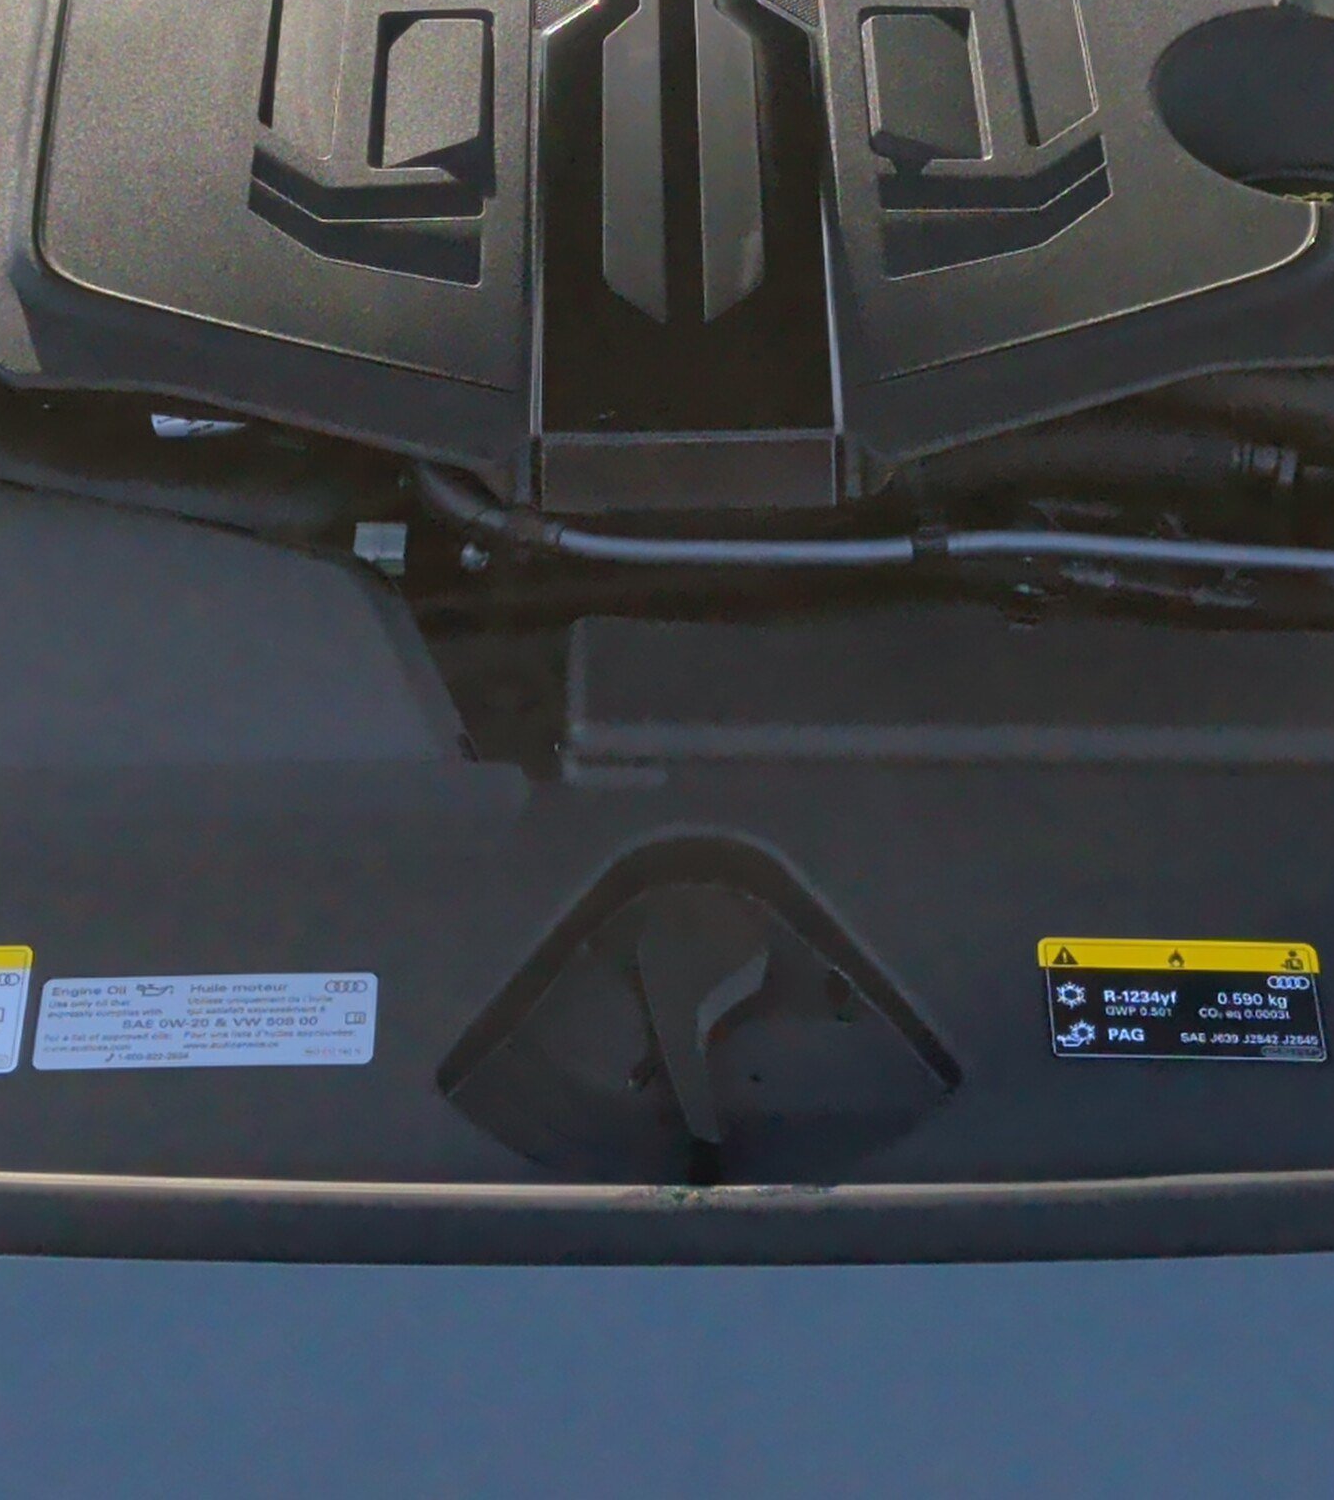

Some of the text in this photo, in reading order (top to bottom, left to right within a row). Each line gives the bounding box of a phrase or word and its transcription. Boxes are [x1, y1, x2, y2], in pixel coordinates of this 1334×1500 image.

[52, 985, 127, 998] Engine Oil
[232, 982, 289, 993] moteur
[1103, 990, 1178, 1006] R-1234yf
[1268, 994, 1289, 1010] kg
[159, 1017, 210, 1029] 0W-20
[232, 1016, 262, 1027] VW
[298, 1015, 319, 1027] 00
[1107, 1028, 1146, 1043] PAG
